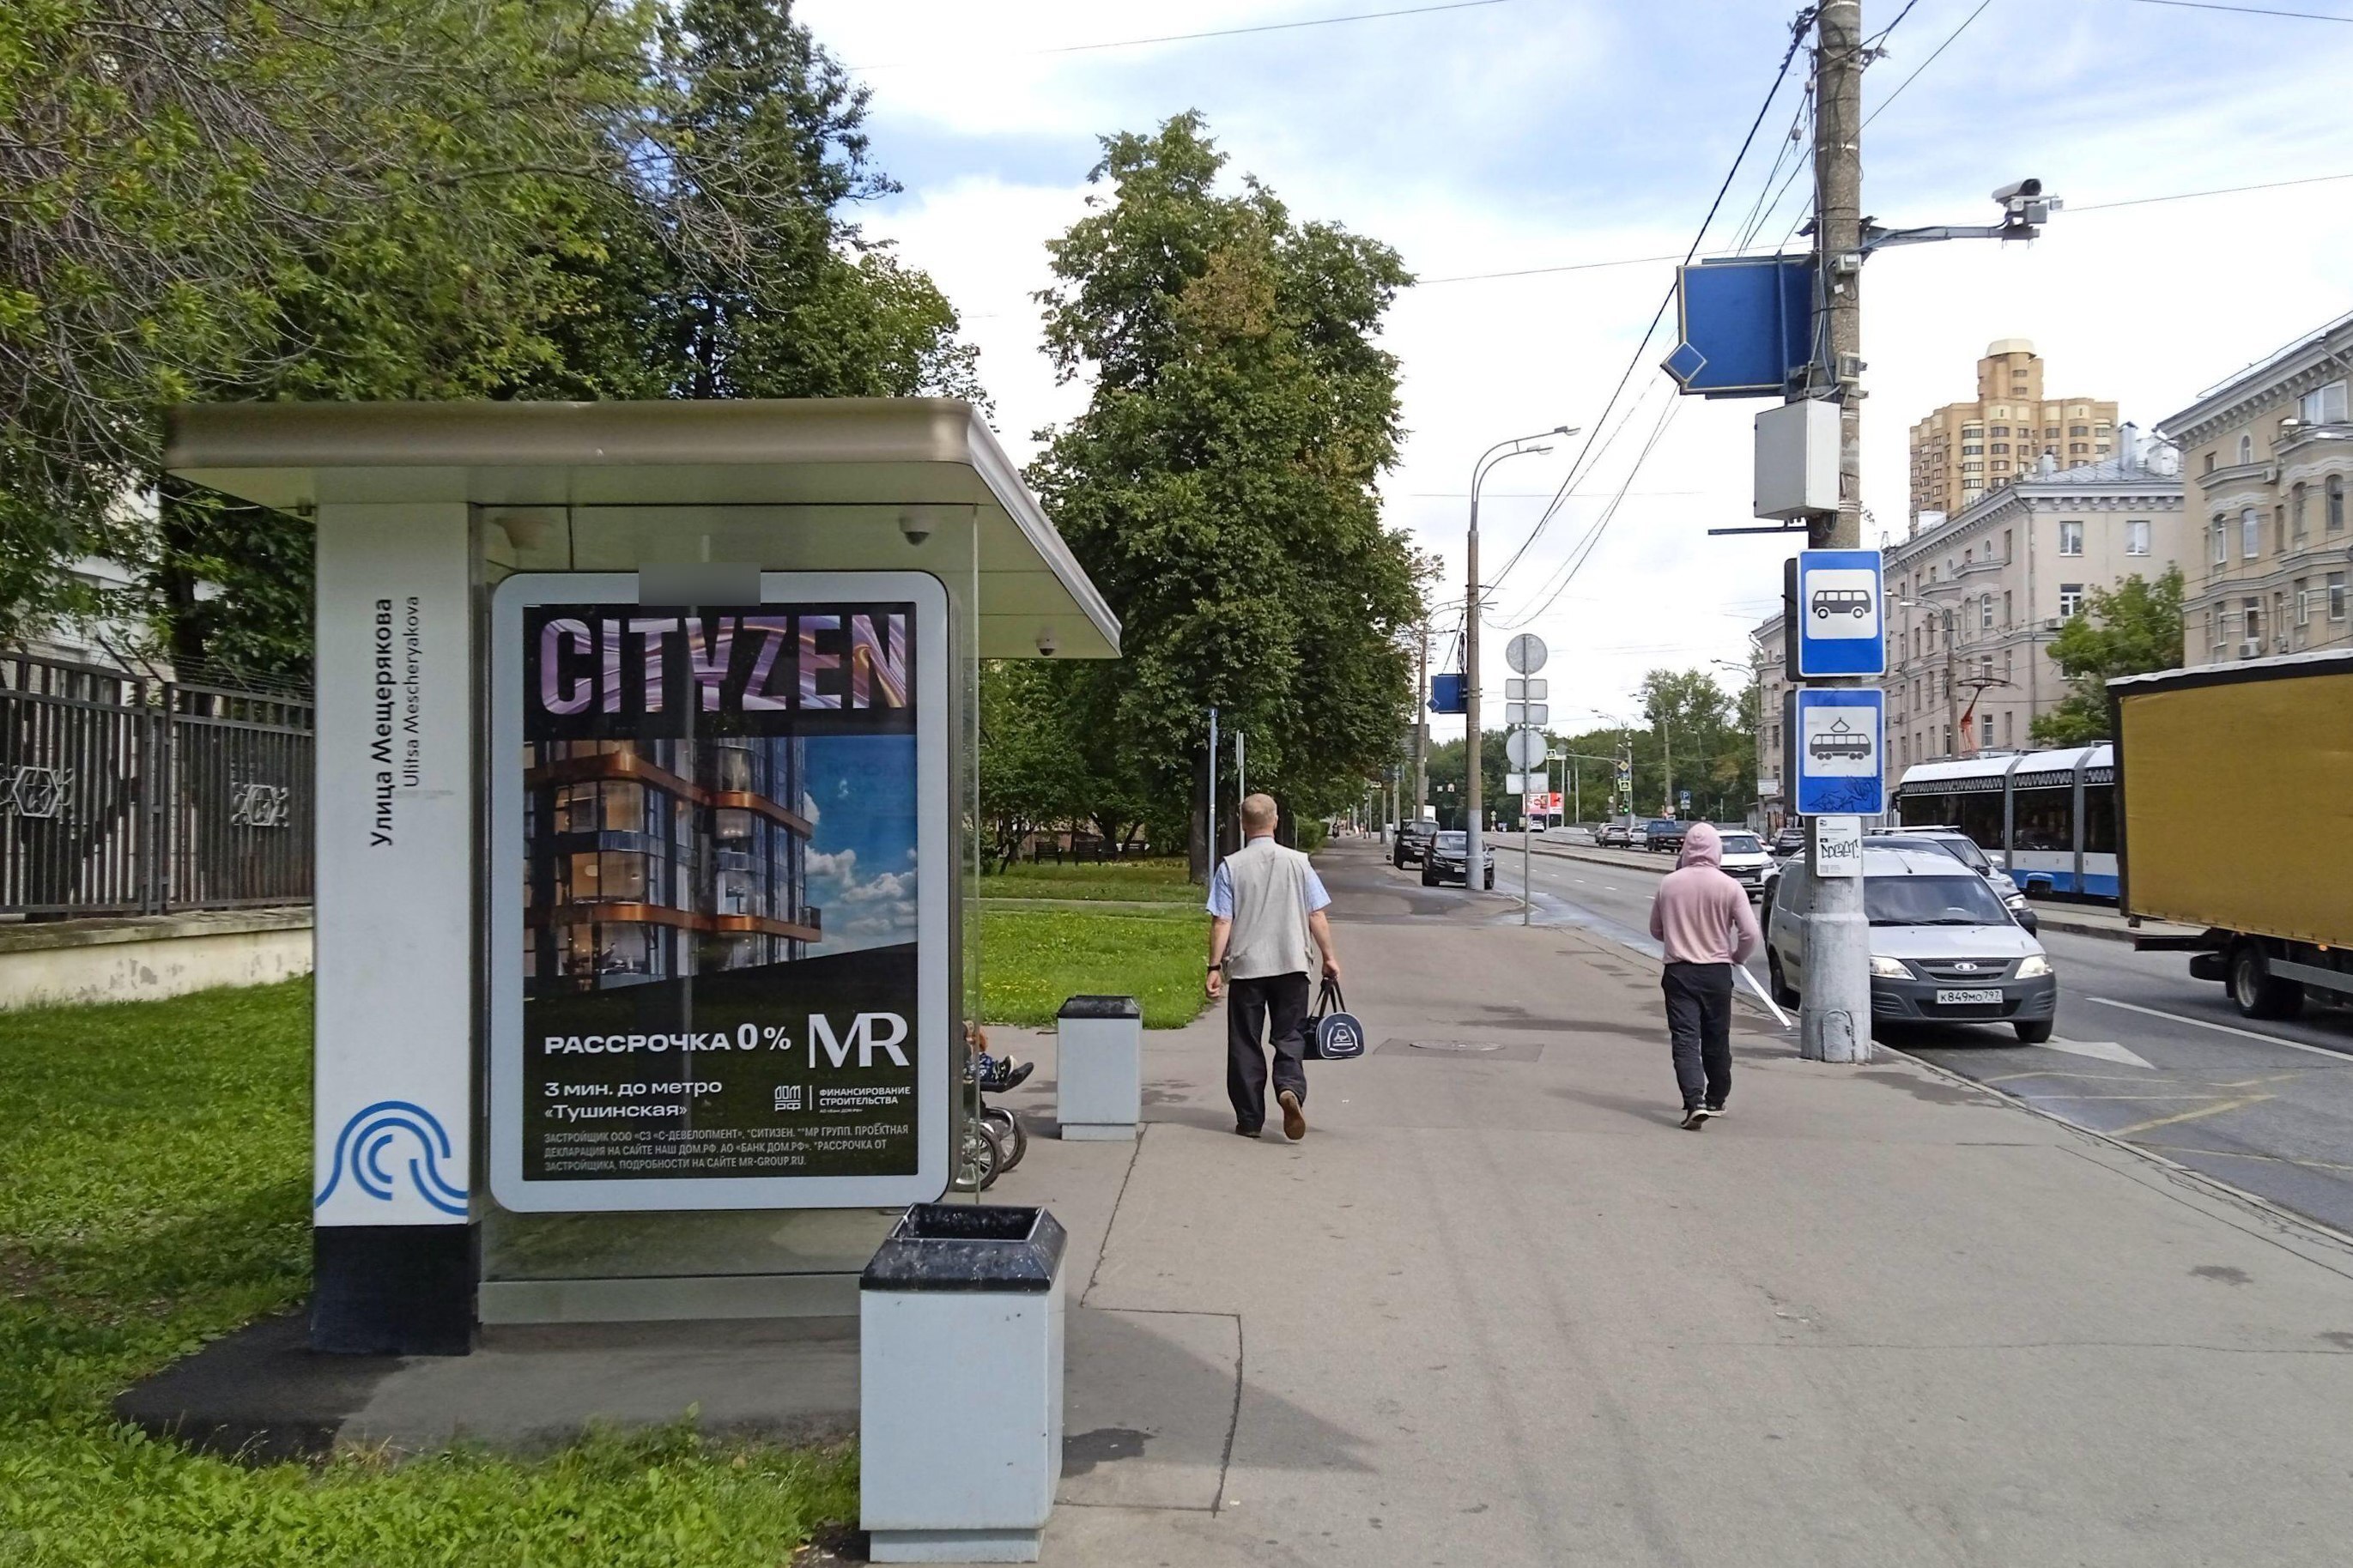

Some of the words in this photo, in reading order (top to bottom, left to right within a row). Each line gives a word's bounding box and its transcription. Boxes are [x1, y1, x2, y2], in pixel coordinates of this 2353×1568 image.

[403, 596, 422, 734] Mescheryakova
[370, 598, 397, 764] Мещерякова
[403, 738, 420, 788] Ulitsa
[370, 771, 395, 847] Улица
[544, 1032, 731, 1054] РАССРОЧКА
[809, 1012, 910, 1069] MR
[544, 1082, 560, 1097] 3
[563, 1083, 613, 1097] мин.
[617, 1083, 646, 1098] до
[652, 1081, 723, 1098] метро
[819, 1087, 911, 1099] ФИНАНСИРОВАНИЕ
[819, 1096, 899, 1106] СТРОИТЕЛЬСТВА
[544, 1105, 688, 1123] «Тушинская»
[544, 1130, 609, 1143] ЗАСТРОЙЩИК
[610, 1131, 632, 1141] ООО
[855, 1124, 909, 1135] ПРОЕКТНАЯ
[544, 1147, 605, 1159] ДЕКЛАРАЦИЯ
[607, 1145, 621, 1155] НА
[622, 1143, 653, 1154] САЙТЕ
[654, 1144, 676, 1154] НАШ
[720, 1143, 734, 1153] АО
[736, 1142, 765, 1153] «БАНК
[874, 1139, 887, 1149] ОТ
[619, 1158, 690, 1171] ПОДРОБНОСТИ
[692, 1157, 705, 1168] НА
[707, 1156, 737, 1168] САЙТЕ
